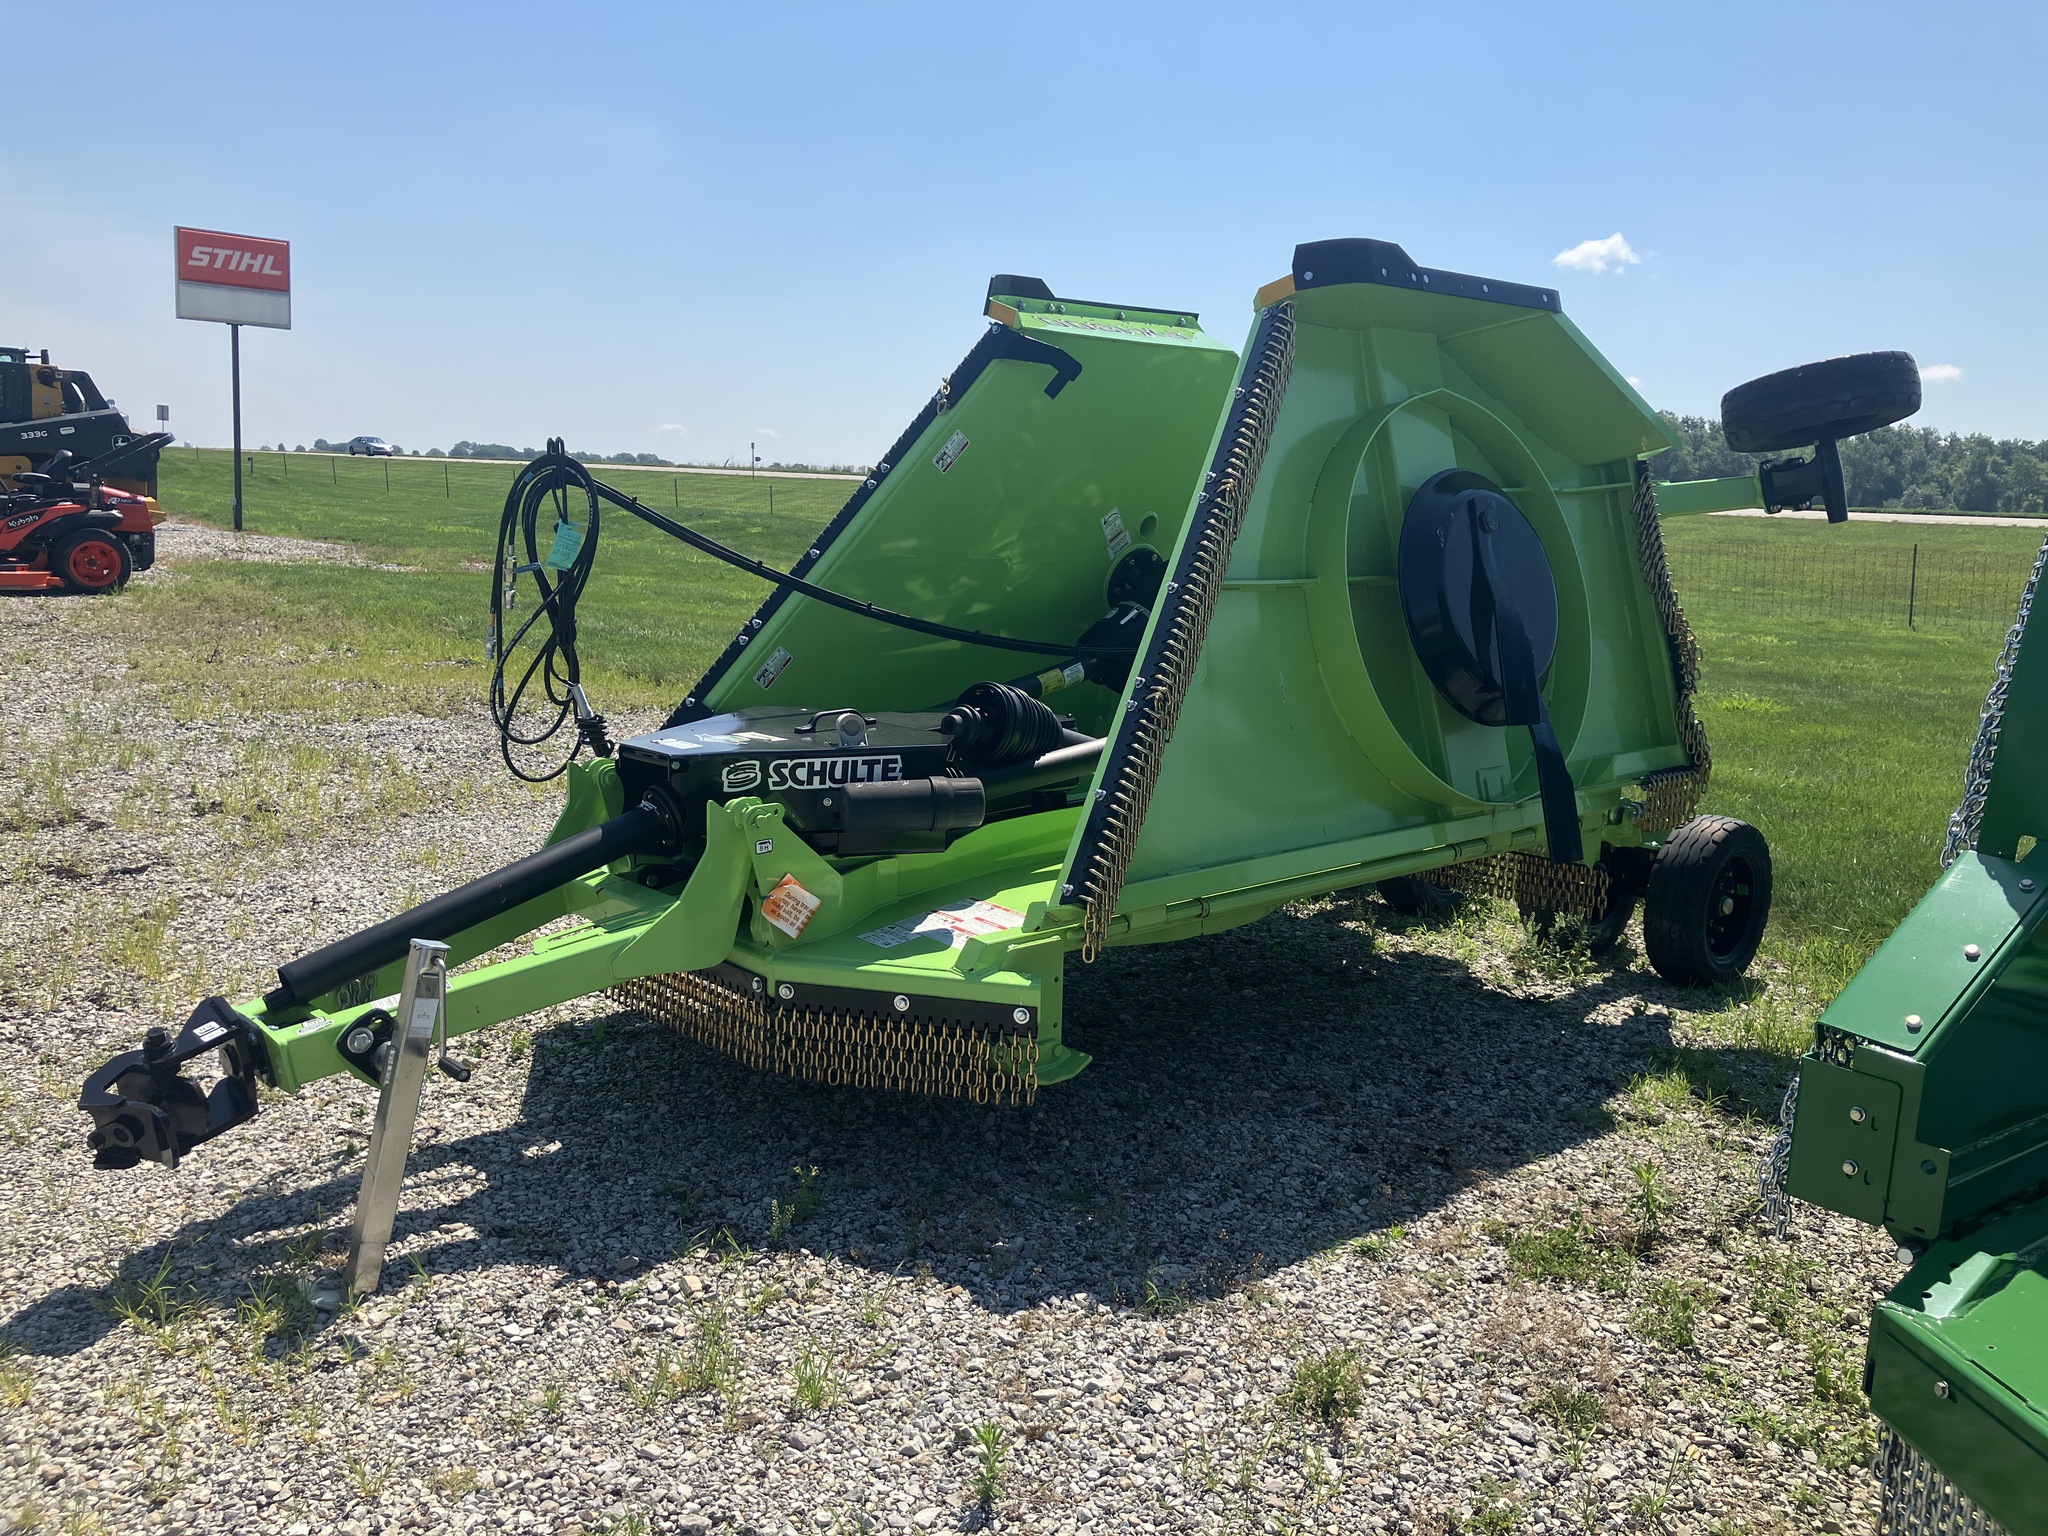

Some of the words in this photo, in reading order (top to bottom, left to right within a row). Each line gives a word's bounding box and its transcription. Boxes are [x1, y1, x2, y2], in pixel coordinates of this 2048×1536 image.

[187, 245, 282, 276] STIHL
[20, 431, 48, 439] 333G
[8, 515, 39, 527] Kubota
[768, 755, 902, 790] SCHULTE
[771, 901, 784, 910] road
[785, 892, 800, 907] During
[780, 898, 790, 907] may
[790, 904, 802, 915] have
[777, 912, 790, 923] soon
